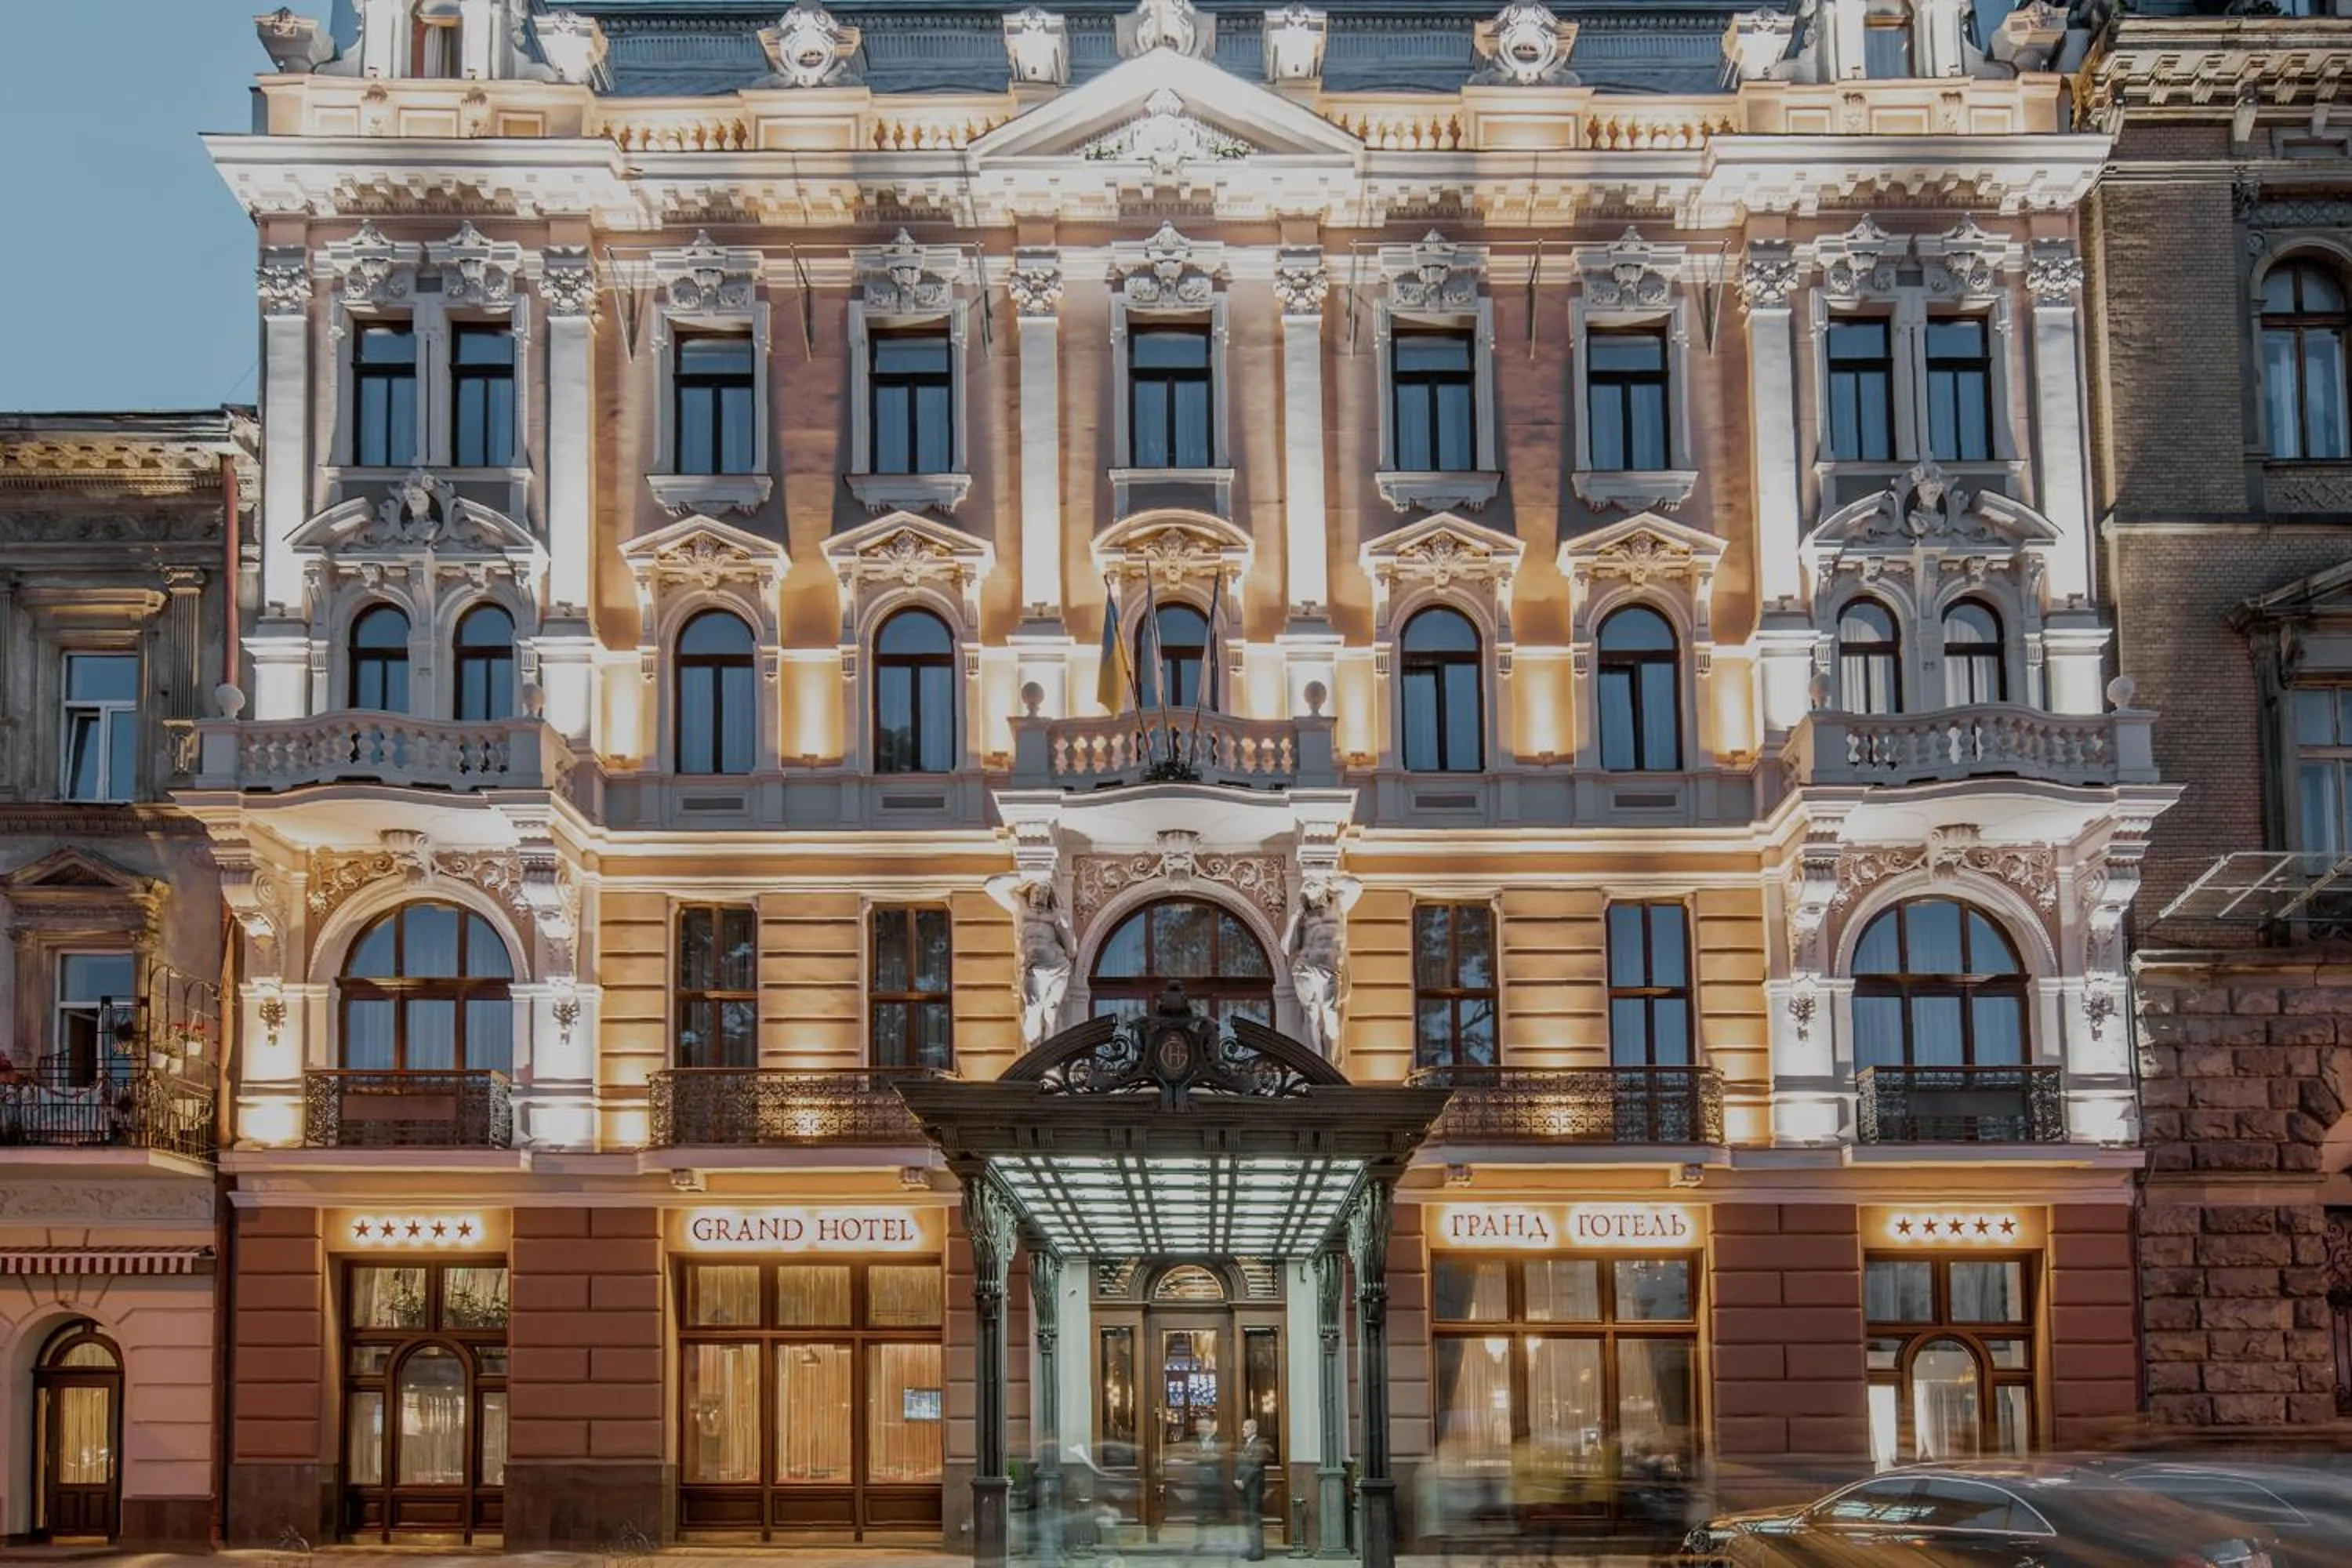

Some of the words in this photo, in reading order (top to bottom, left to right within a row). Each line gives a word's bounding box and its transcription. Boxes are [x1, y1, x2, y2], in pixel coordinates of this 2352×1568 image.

[693, 1218, 804, 1241] GRAND
[818, 1218, 913, 1241] HOTEL
[1451, 1214, 1549, 1242] ГРАНД
[1577, 1214, 1686, 1237] ГОТЕЛЬ
